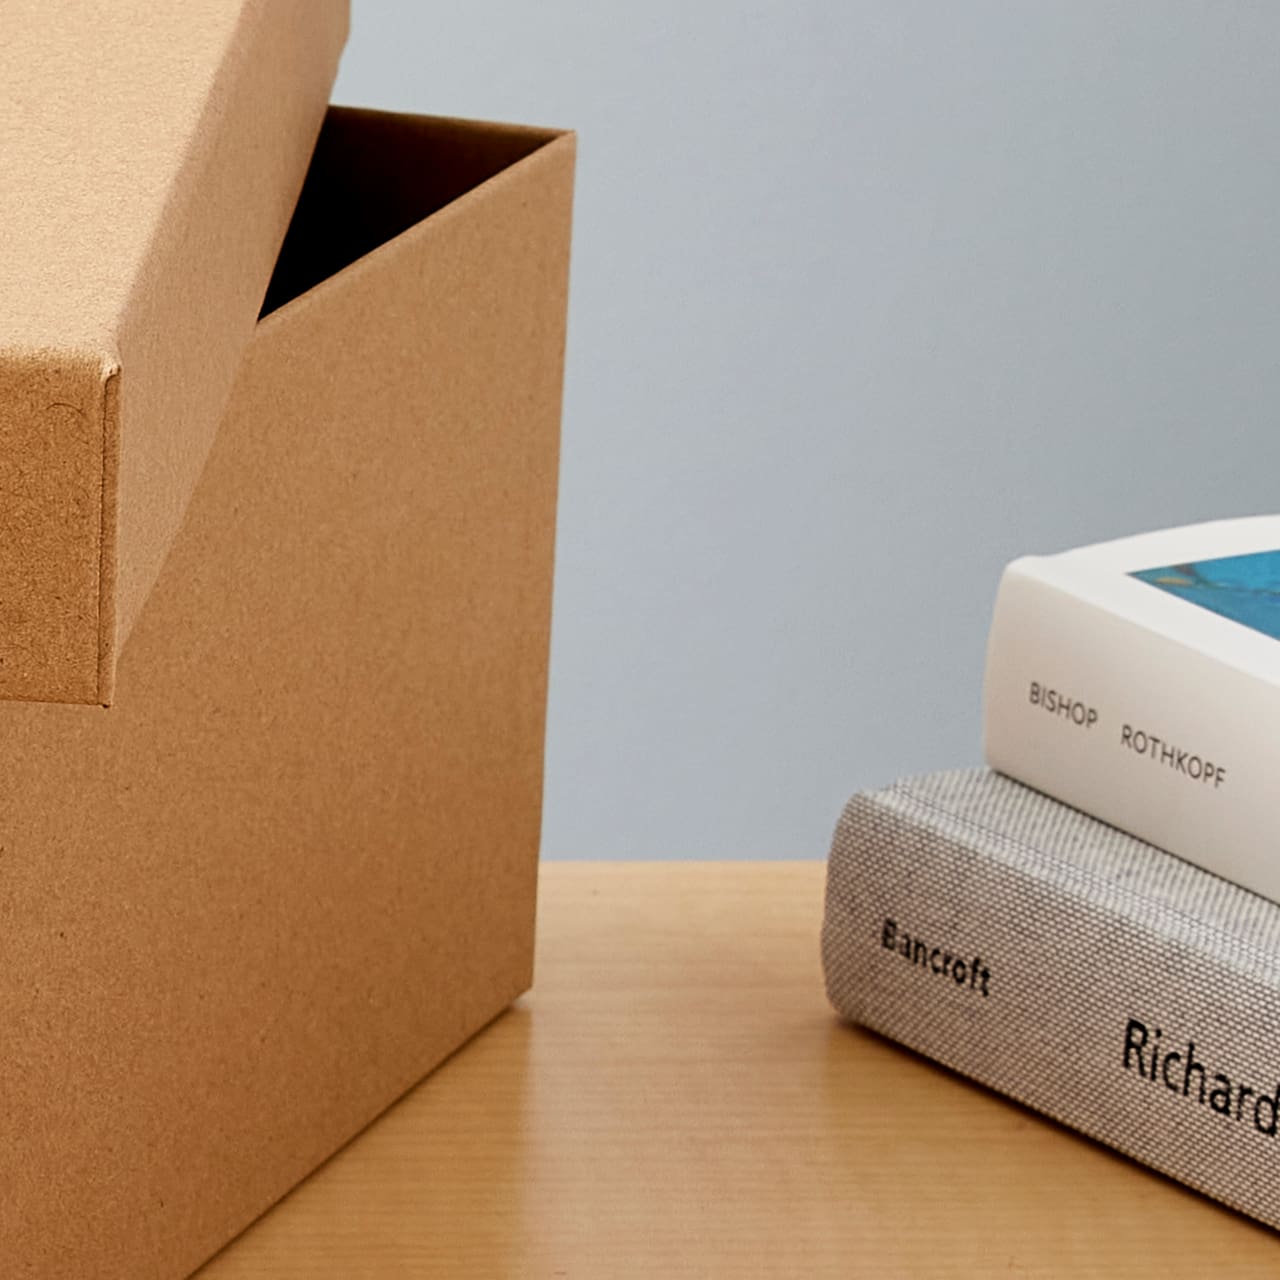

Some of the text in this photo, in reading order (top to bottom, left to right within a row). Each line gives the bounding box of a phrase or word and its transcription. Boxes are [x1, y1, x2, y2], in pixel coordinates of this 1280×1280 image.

[1028, 681, 1227, 789] BISHOP ROTHKOPF
[881, 919, 1280, 1137] Bancroft Richard
